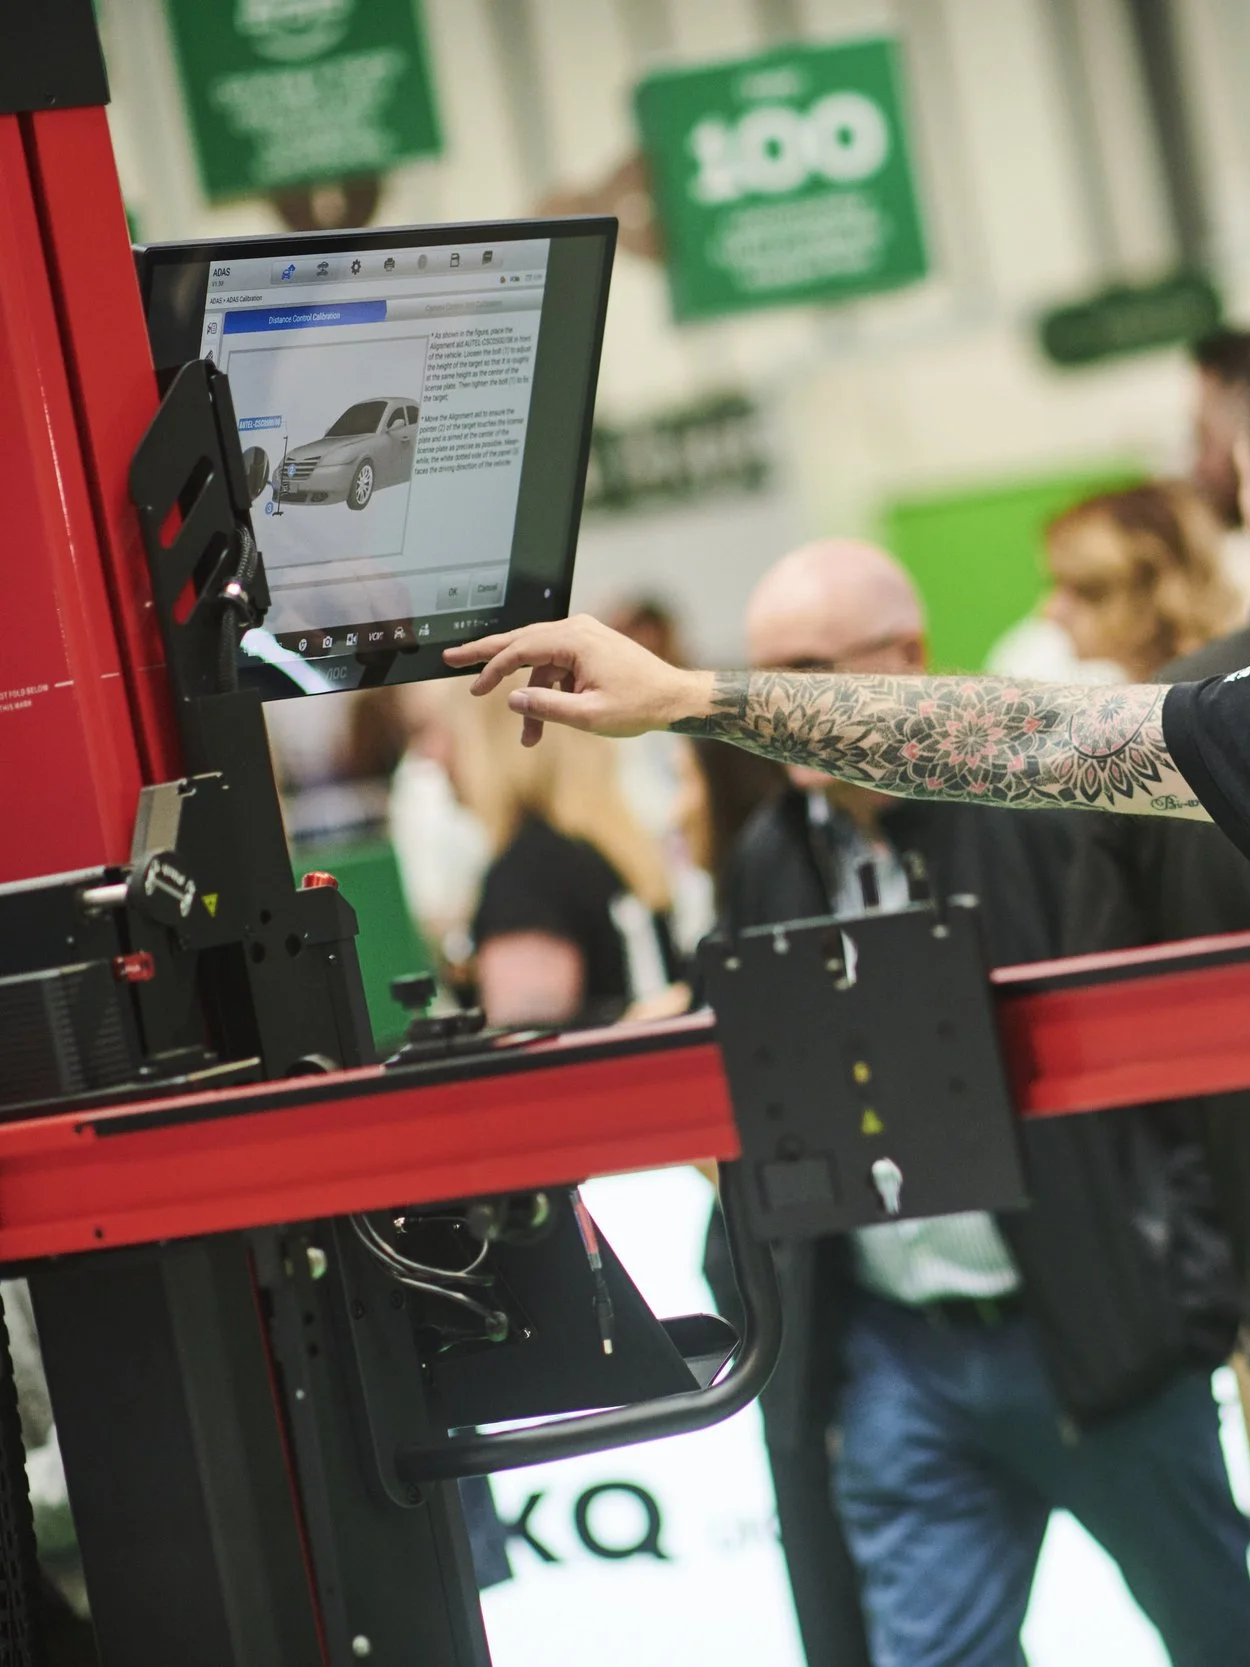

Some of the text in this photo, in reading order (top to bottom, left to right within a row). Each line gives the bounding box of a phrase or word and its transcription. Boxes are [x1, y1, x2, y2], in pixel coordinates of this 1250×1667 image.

[689, 88, 890, 205] 100
[213, 268, 231, 277] ADAS
[239, 295, 263, 303] Calibration
[268, 311, 341, 325] Distance Control Calibration
[26, 684, 49, 695] BELOW
[503, 1482, 672, 1563] KQ
